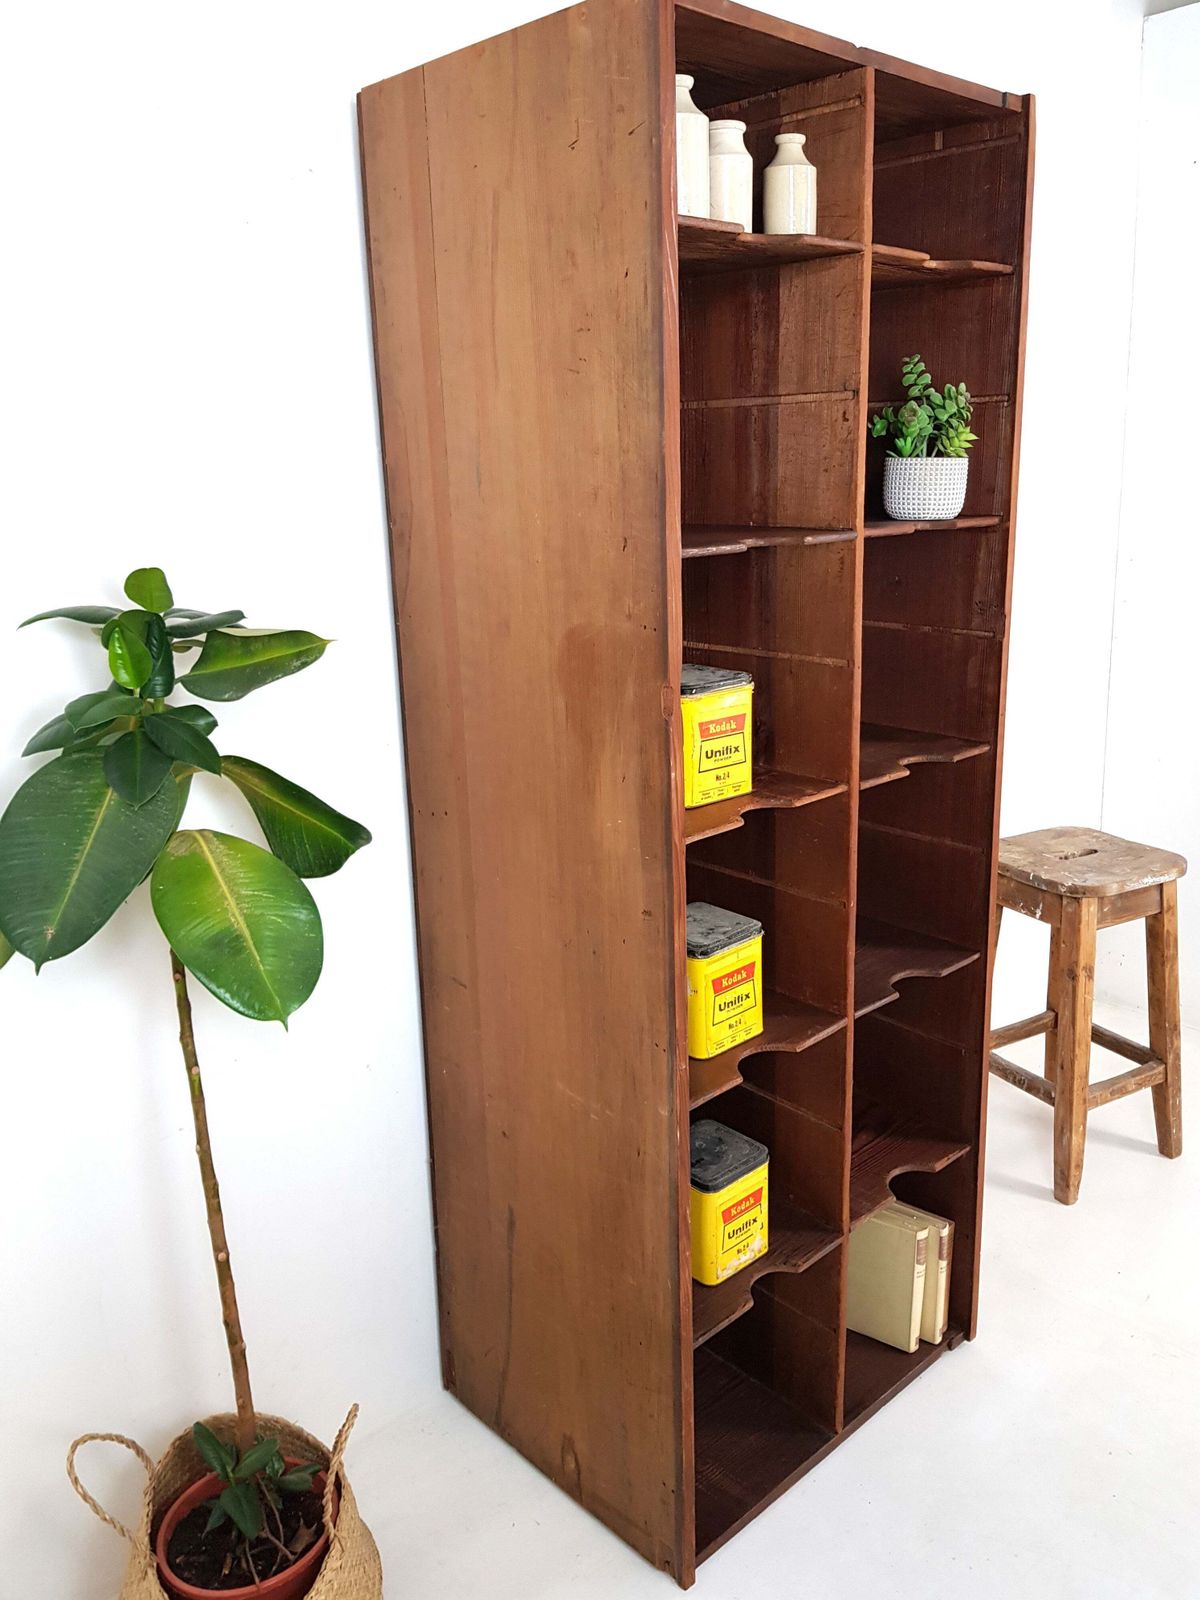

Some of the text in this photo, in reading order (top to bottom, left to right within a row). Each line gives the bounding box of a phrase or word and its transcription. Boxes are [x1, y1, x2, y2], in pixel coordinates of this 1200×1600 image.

[709, 720, 737, 734] Kodak
[705, 745, 740, 760] Unifix
[722, 970, 747, 988] Kodak
[718, 992, 751, 1012] Unifix
[731, 1197, 755, 1217] Kodak
[728, 1216, 758, 1240] Unifix
